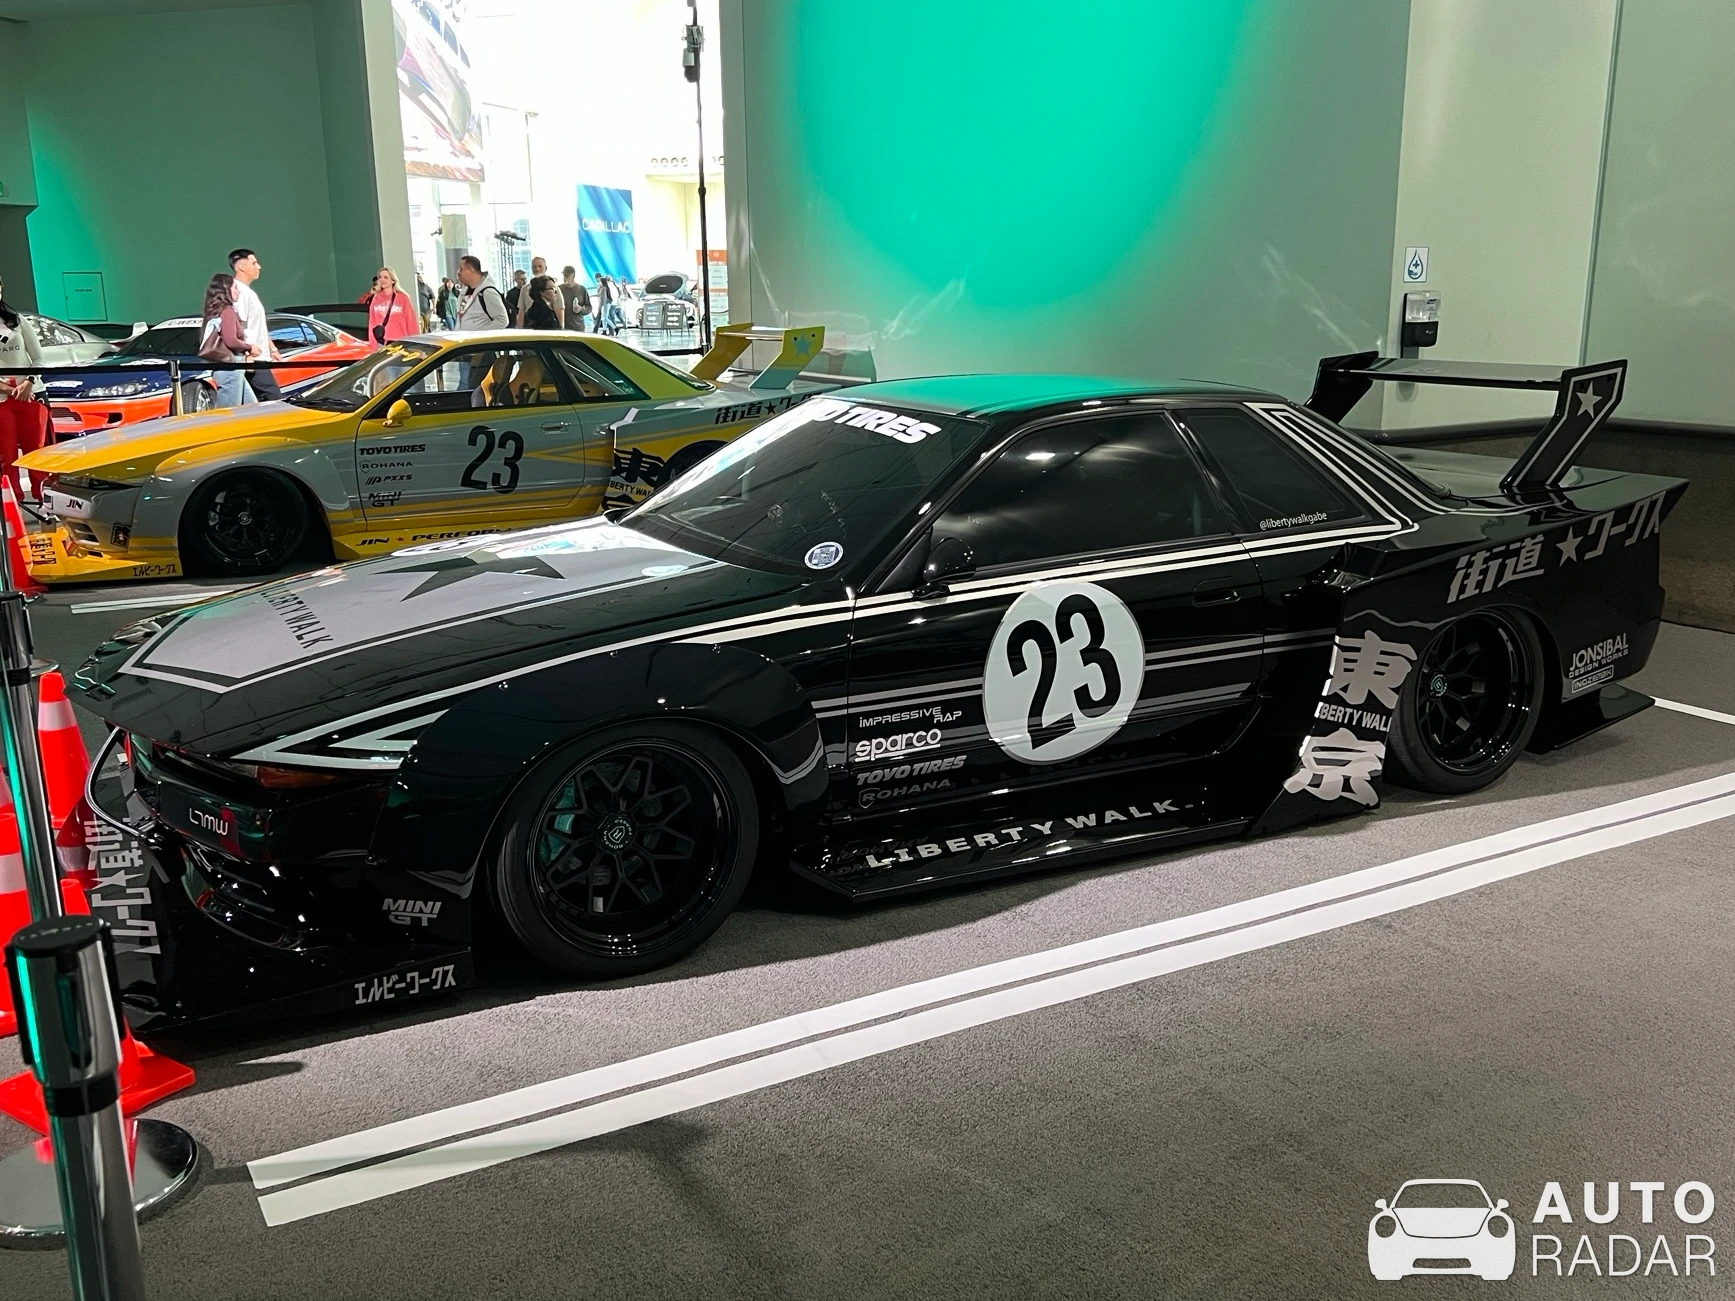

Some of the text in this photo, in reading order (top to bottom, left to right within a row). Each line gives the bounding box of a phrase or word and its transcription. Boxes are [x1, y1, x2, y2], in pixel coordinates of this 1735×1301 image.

[582, 217, 631, 233] CADILLAC
[834, 406, 942, 444] TIRES
[392, 444, 426, 453] TIRES
[460, 425, 524, 494] 23
[361, 461, 413, 470] ROHANA
[66, 499, 84, 510] JIN
[1259, 511, 1328, 531] @libertywalkgabe
[355, 537, 390, 546] JIN
[1569, 632, 1629, 671] JONSIBAL
[1006, 593, 1122, 750] 23
[855, 728, 942, 761] sparco
[856, 754, 968, 786] TOYO TIRES
[861, 778, 951, 802] ROHANA
[865, 820, 1054, 869] LIBERTY
[381, 898, 442, 914] MINI
[388, 911, 438, 927] GT
